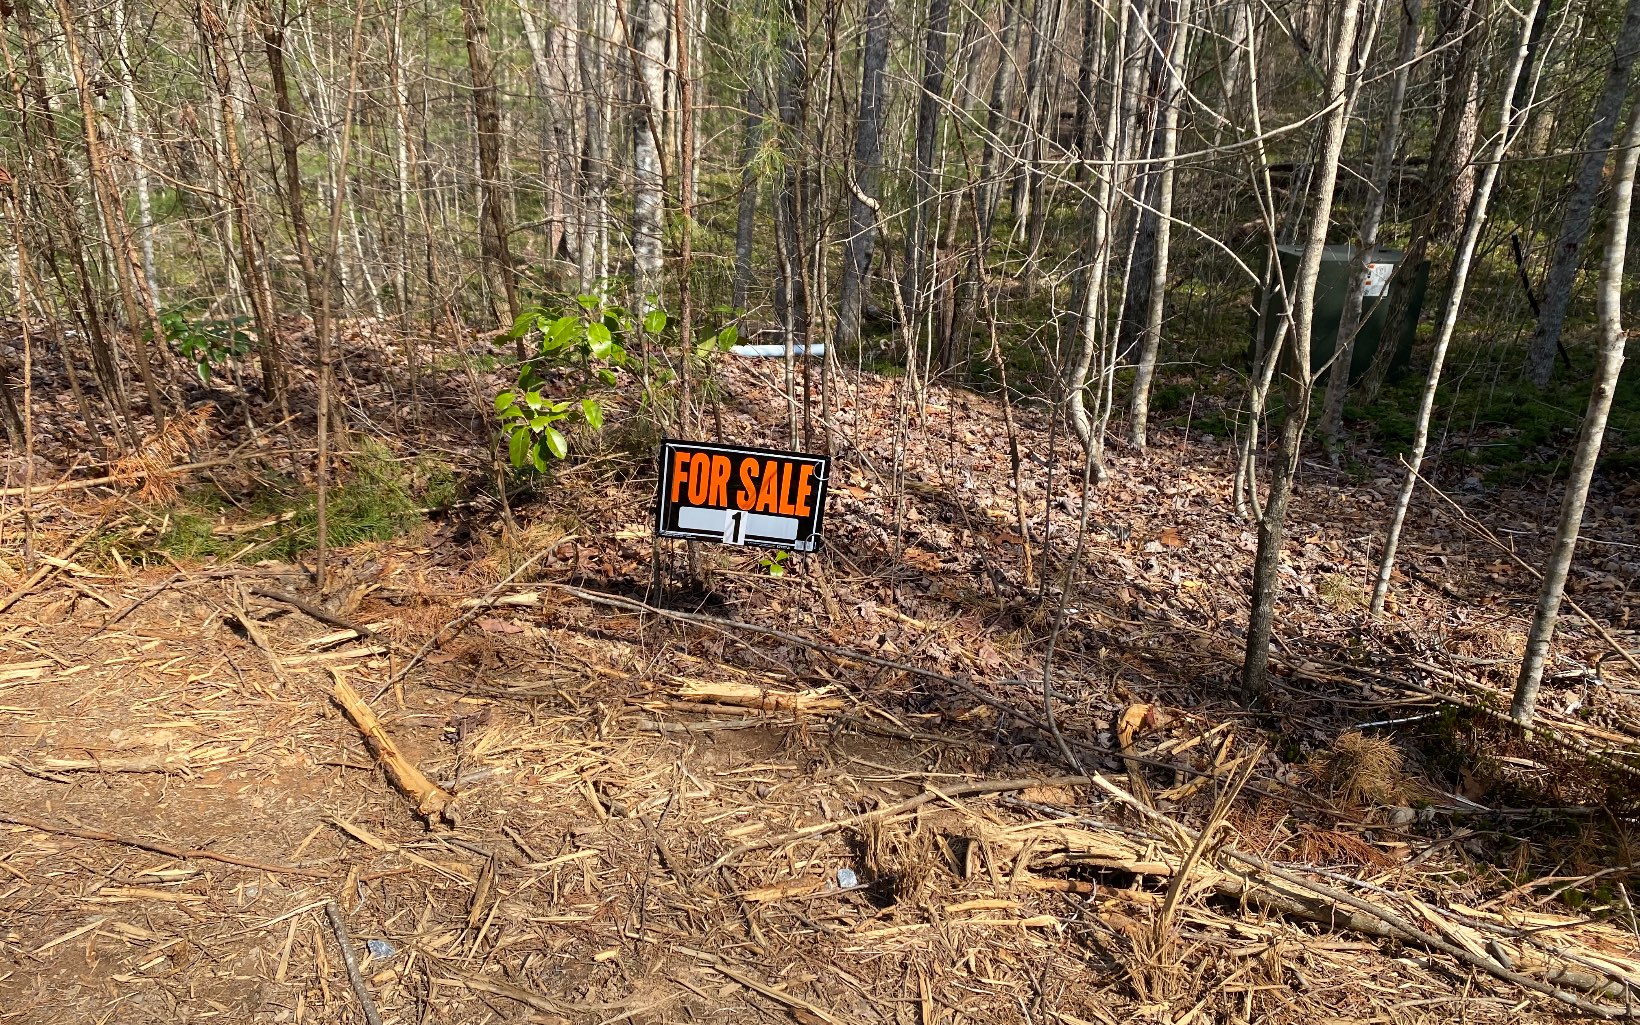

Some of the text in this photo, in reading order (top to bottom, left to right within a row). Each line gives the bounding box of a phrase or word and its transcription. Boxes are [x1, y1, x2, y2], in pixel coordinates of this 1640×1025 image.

[671, 451, 814, 517] FOR SALE
[731, 512, 742, 543] 1
